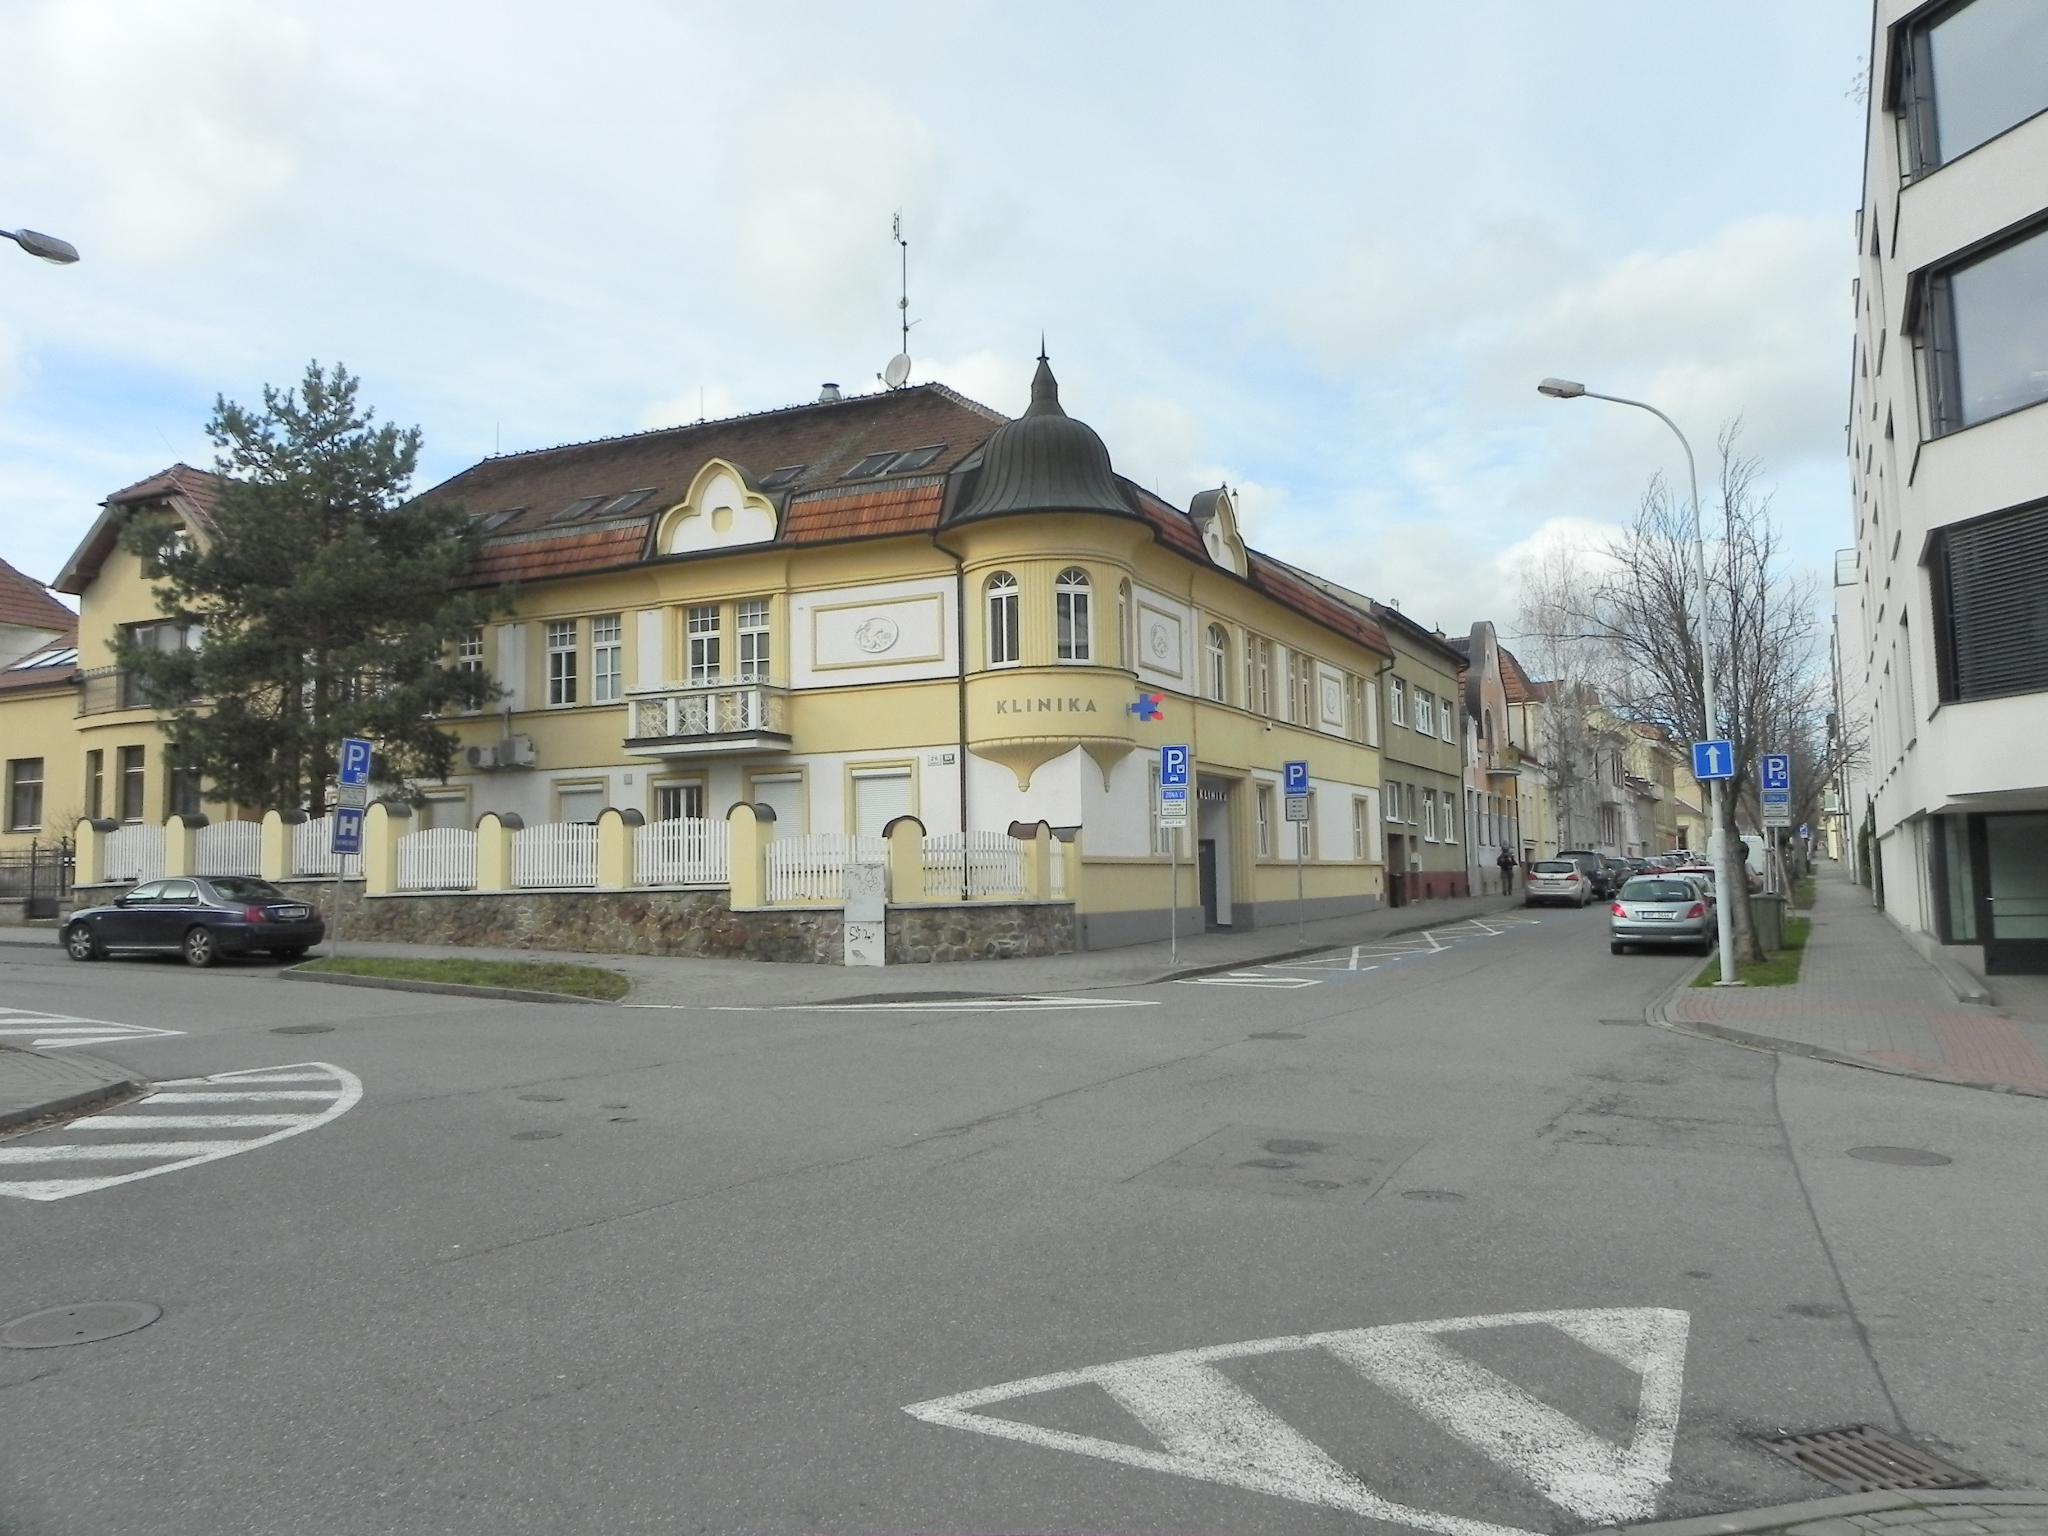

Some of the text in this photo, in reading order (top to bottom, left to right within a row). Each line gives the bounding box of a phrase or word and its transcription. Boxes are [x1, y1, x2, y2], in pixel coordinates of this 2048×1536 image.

[996, 697, 1097, 714] KLINIKA
[348, 745, 365, 771] P
[1167, 749, 1184, 774] P
[1768, 758, 1784, 779] P
[1290, 765, 1304, 786] P
[338, 815, 359, 836] H
